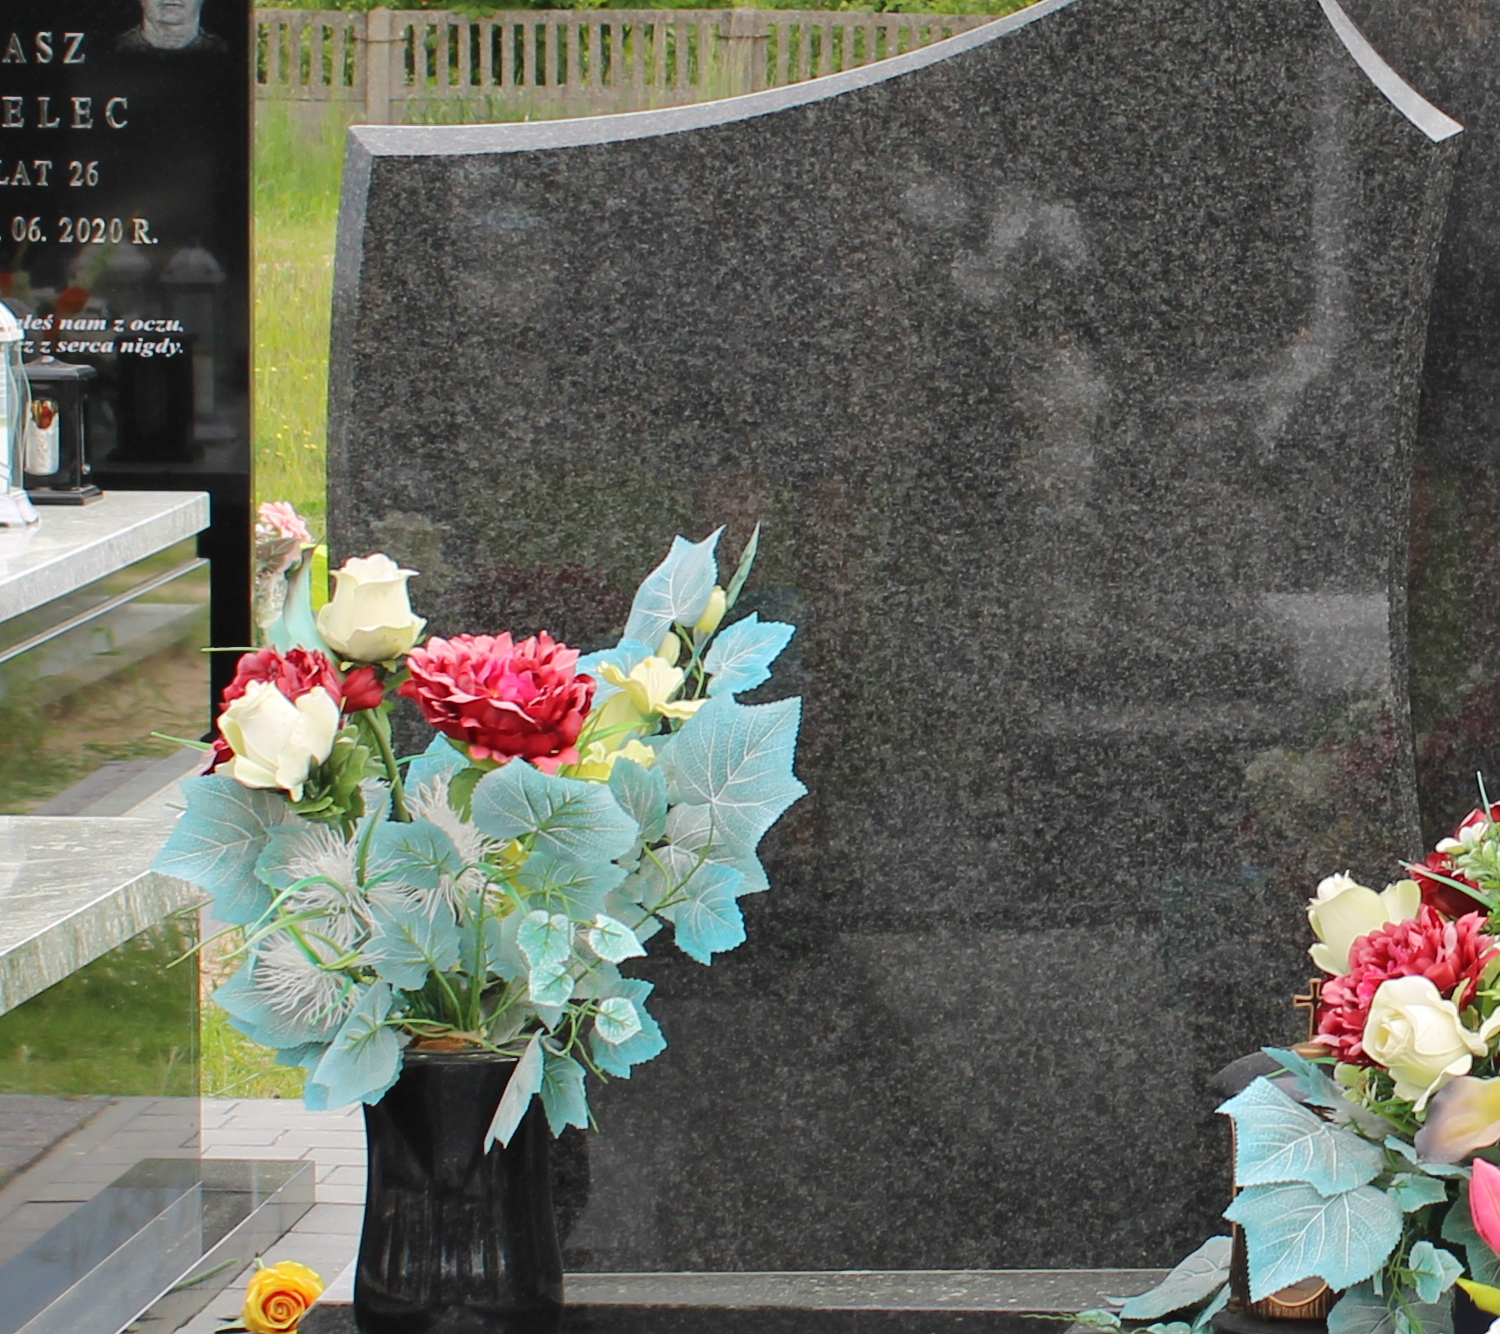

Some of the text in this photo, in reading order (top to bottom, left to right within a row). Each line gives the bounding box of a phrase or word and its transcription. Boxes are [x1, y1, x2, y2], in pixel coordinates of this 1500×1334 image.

[68, 160, 100, 188] 26
[58, 217, 125, 244] 2020
[131, 218, 159, 245] R.
[58, 318, 106, 331] nam
[113, 318, 125, 332] z
[40, 340, 51, 354] z
[56, 340, 115, 354] serca
[120, 338, 184, 358] nigdy.
